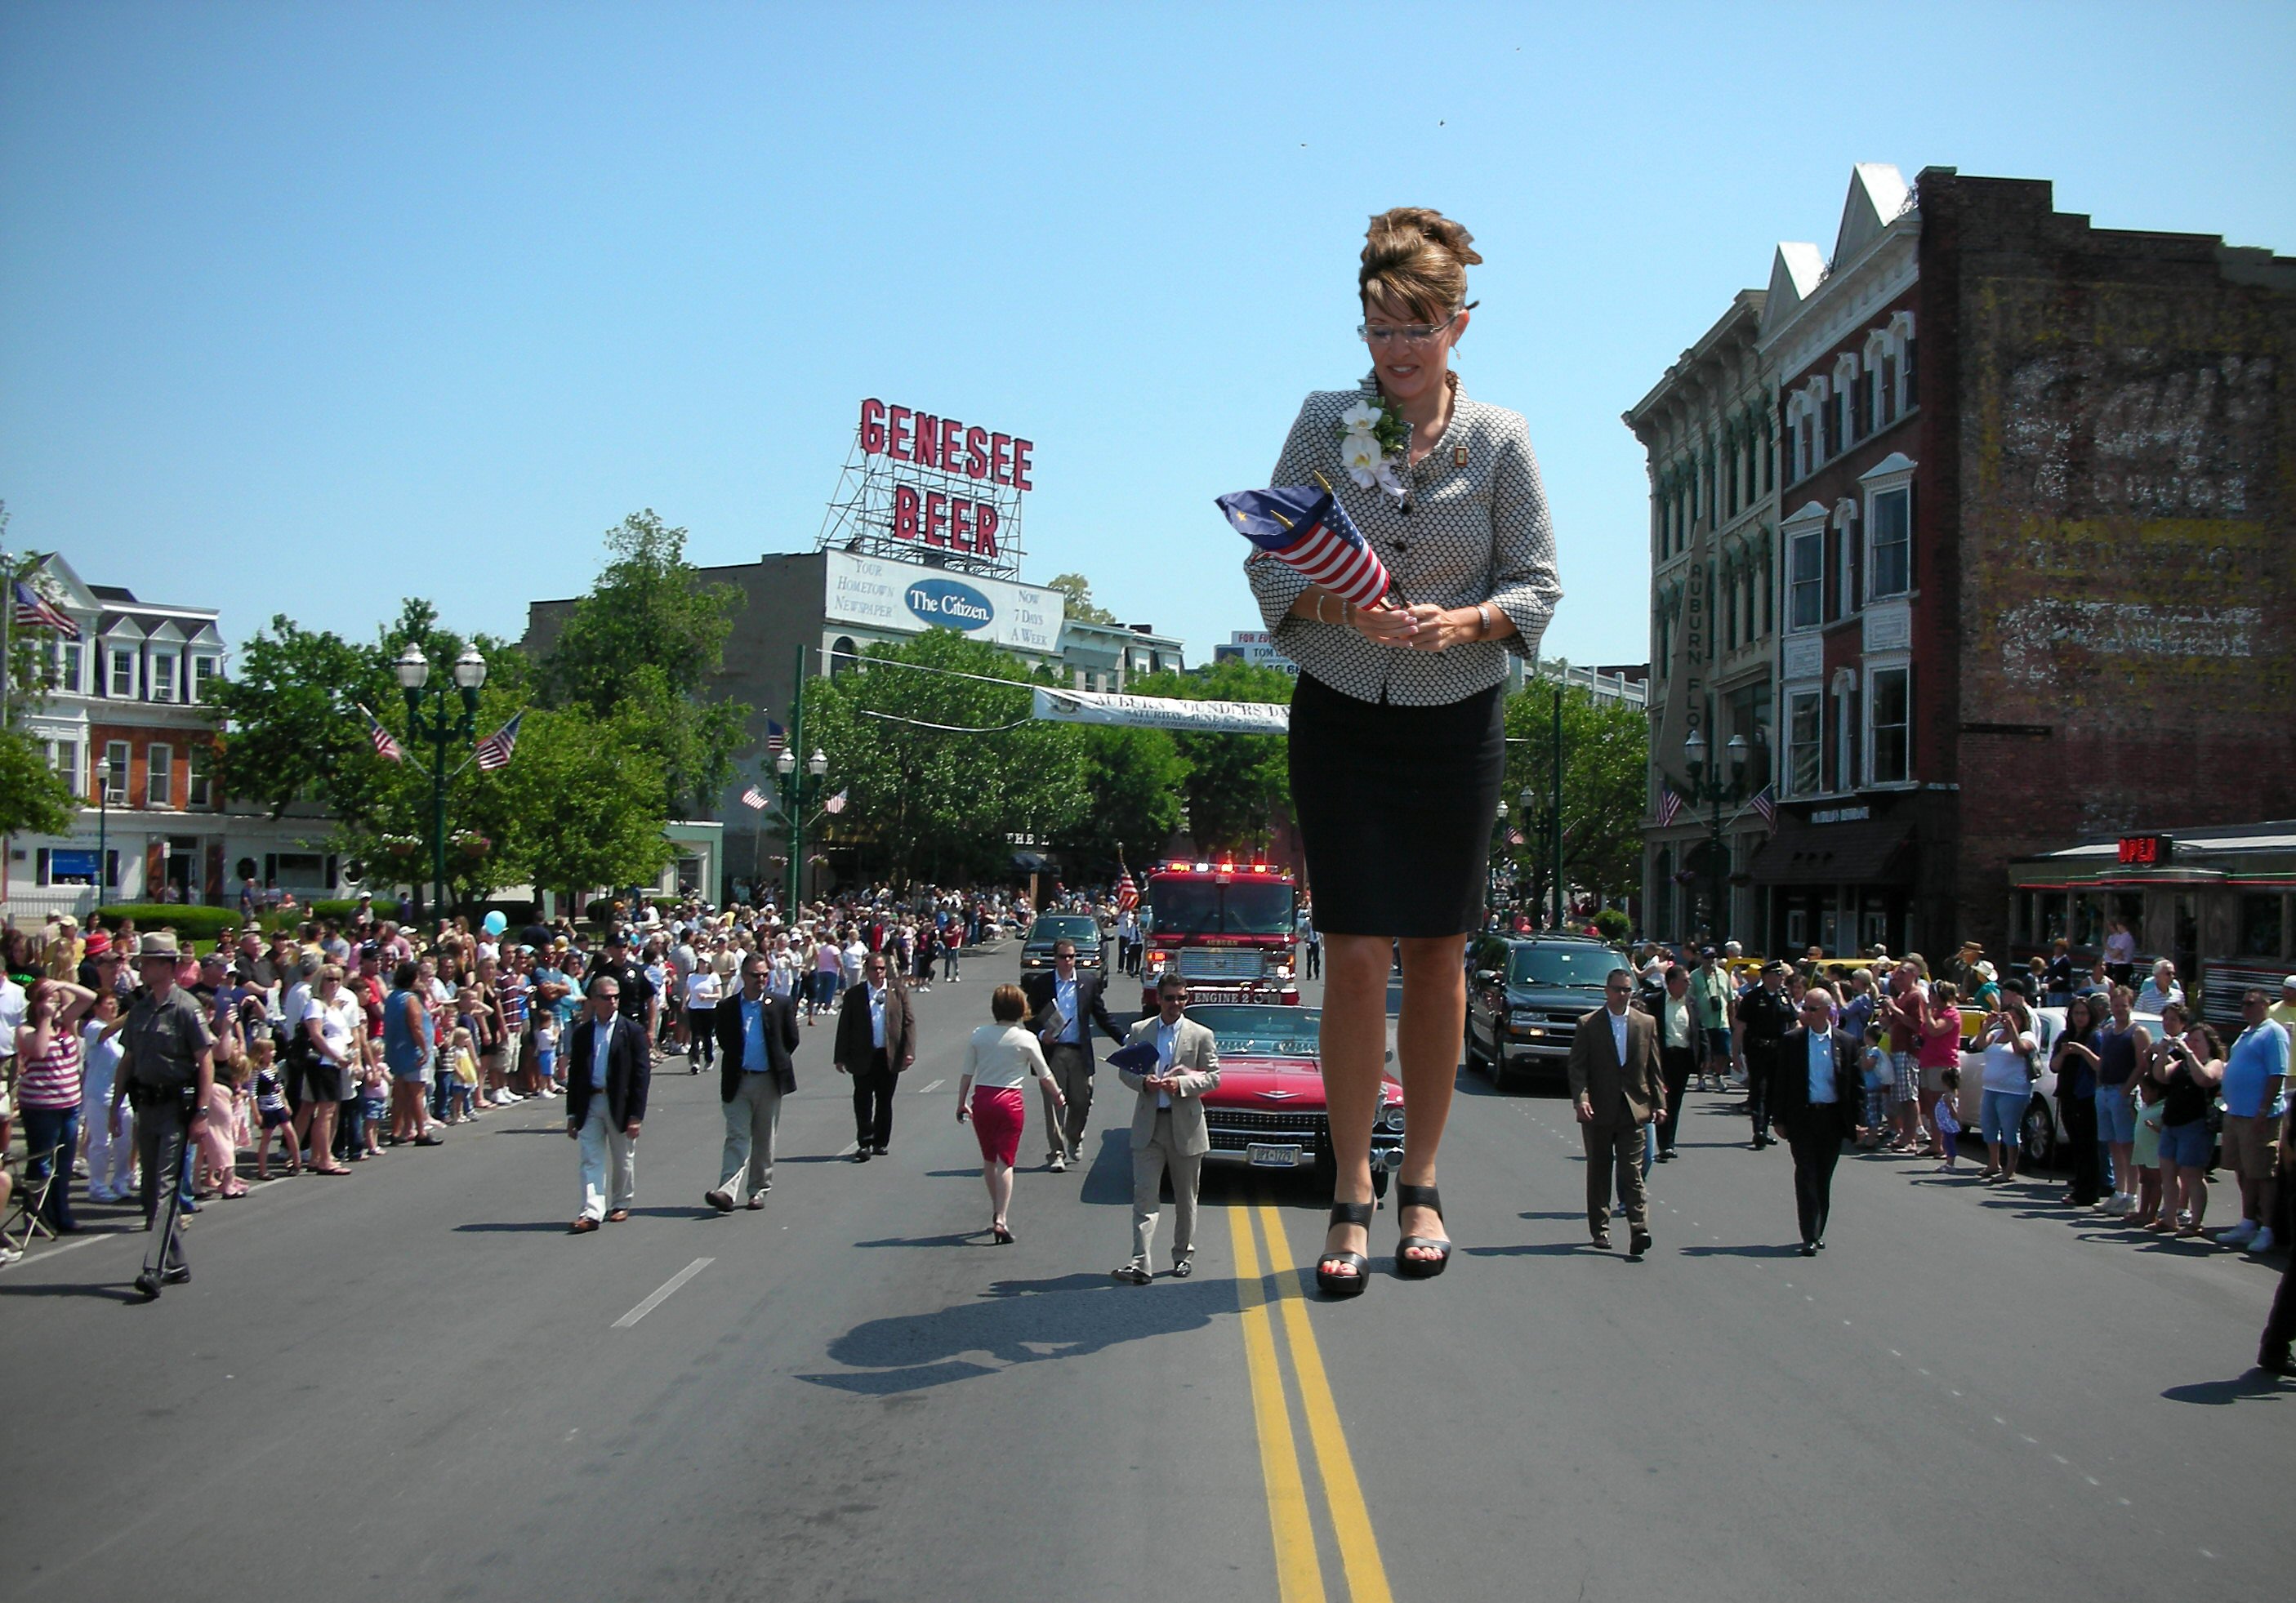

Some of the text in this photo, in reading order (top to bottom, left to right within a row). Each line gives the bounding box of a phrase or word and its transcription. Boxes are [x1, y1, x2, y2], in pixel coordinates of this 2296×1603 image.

[861, 398, 1033, 491] GENESEE
[894, 484, 998, 557] BEER
[855, 559, 882, 577] YOUR
[837, 575, 894, 597] HOMETOWN
[911, 590, 938, 612] The
[1019, 590, 1040, 604] NOW
[834, 595, 894, 617] NEWSPAPER
[1014, 609, 1043, 626] 7 DAYS
[1011, 629, 1047, 646] A WEEK
[1238, 634, 1255, 643] FOR
[1254, 648, 1273, 657] TOM
[1686, 563, 1702, 734] AUBURN FLO
[1268, 705, 1291, 718] DA
[1005, 833, 1035, 845] THE
[2118, 837, 2156, 863] OPEN
[1194, 992, 1250, 1003] ENGINE 2
